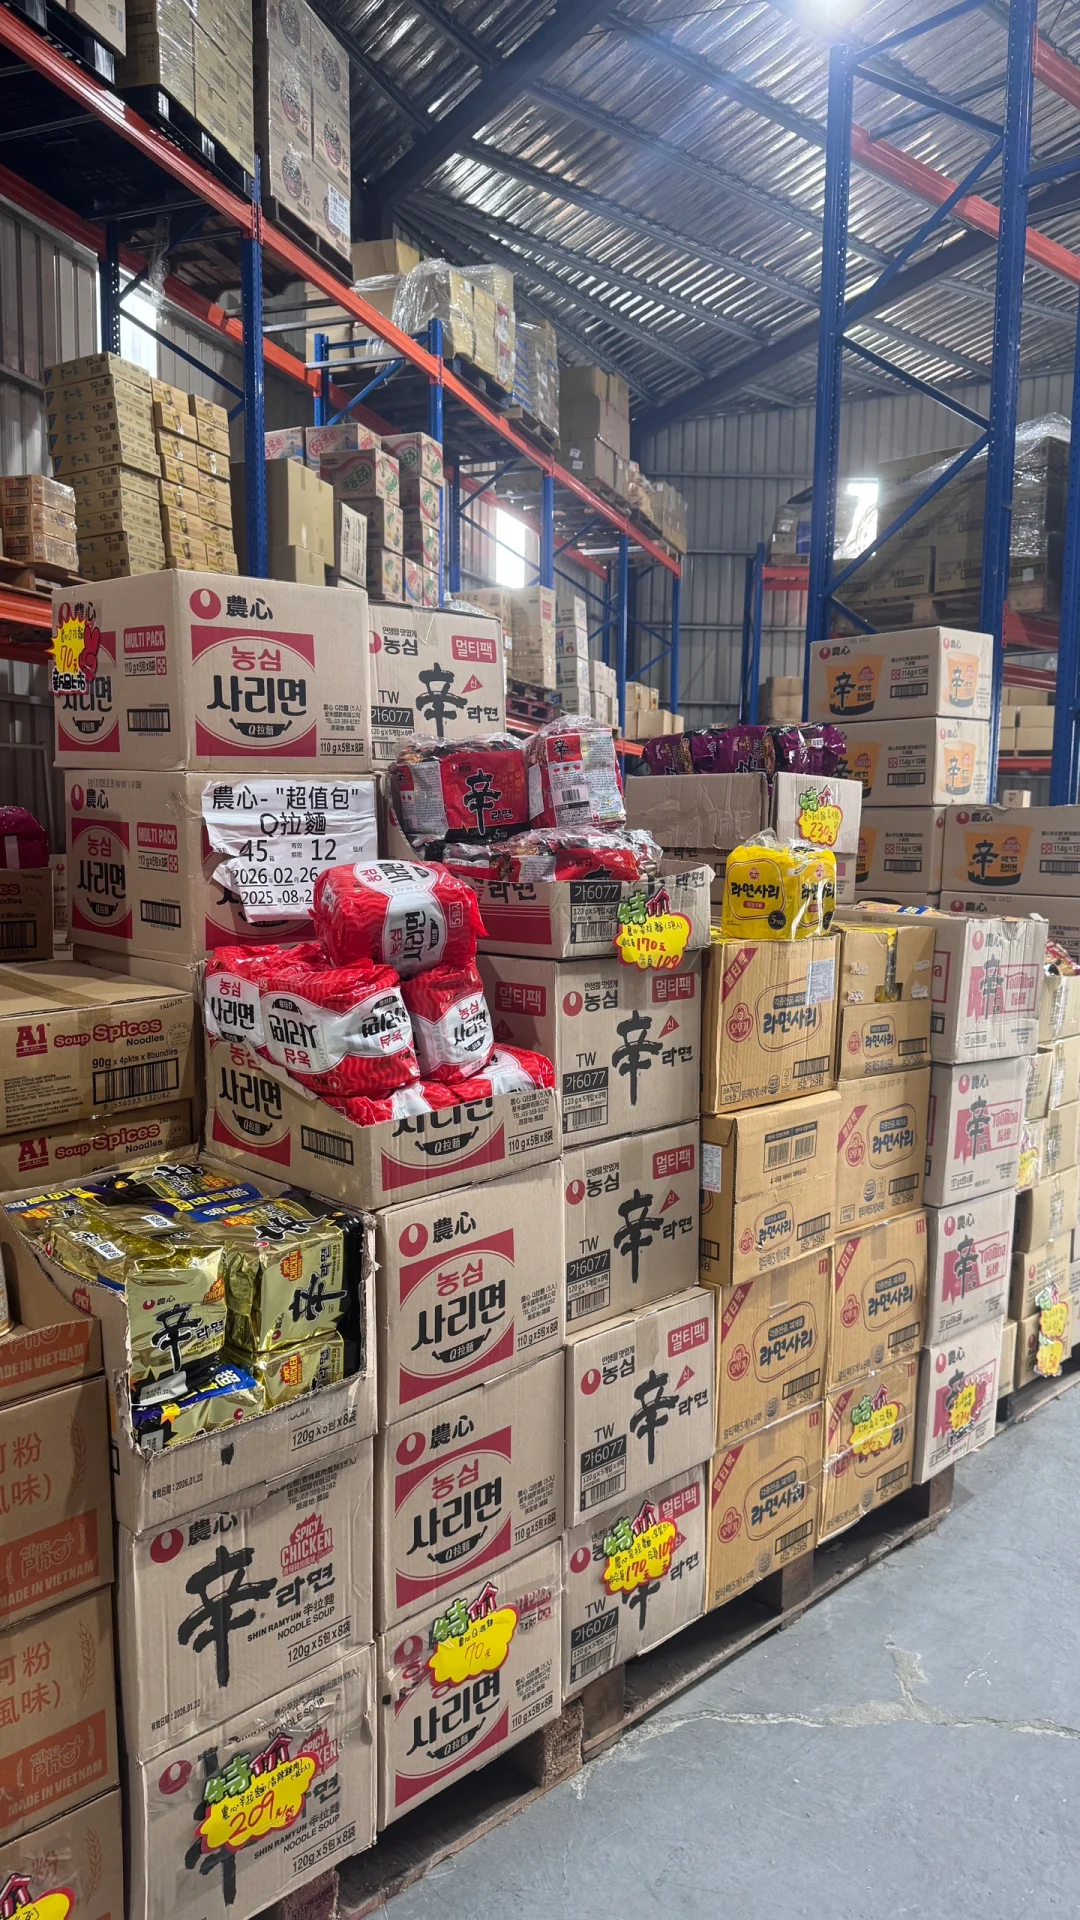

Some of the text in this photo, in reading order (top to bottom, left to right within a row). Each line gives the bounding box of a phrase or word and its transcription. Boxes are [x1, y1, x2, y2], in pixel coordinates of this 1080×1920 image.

[226, 594, 273, 620] 農心
[125, 631, 164, 648] MULTI PACK
[382, 635, 418, 656] 농심
[455, 638, 493, 660] 멀티팩
[231, 646, 281, 672] 농심
[206, 675, 307, 716] 사리면
[378, 690, 400, 704] TW
[415, 662, 468, 737] 辛
[833, 671, 856, 710] 辛
[371, 709, 411, 724] 가6077
[466, 705, 500, 723] 라면
[248, 724, 274, 736] Q拉麵
[86, 788, 109, 809] 農心
[212, 785, 268, 810] 農心-
[463, 768, 501, 836] 辛
[260, 812, 326, 837] Q拉麵
[490, 808, 513, 822] 라면
[87, 834, 112, 857] 농심
[137, 826, 176, 845] MULTI PACK
[239, 839, 268, 862] 45
[311, 839, 337, 861] 12
[972, 839, 1000, 879] 辛
[77, 860, 127, 899] 사리면
[573, 884, 619, 900] 가6077
[731, 881, 780, 900] 라면사리
[617, 886, 671, 924] 特价
[404, 911, 427, 961] 사리면
[724, 951, 749, 988] 멀티팩
[219, 978, 241, 997] 농심
[500, 988, 541, 1012] 멀티팩
[656, 976, 691, 998] 멀티팩
[159, 999, 183, 1011] TAIWAN
[584, 990, 618, 1012] 농심
[54, 1019, 162, 1048] Soup Spices
[268, 1014, 317, 1048] 사리면
[666, 1018, 674, 1030] 신
[763, 1007, 817, 1034] 라면사리
[16, 1023, 47, 1048] A1
[126, 1033, 164, 1047] Noodles
[865, 1030, 894, 1048] 라면사리
[92, 1057, 111, 1069] 90g
[119, 1054, 139, 1066] 4pkts
[146, 1048, 178, 1060] 8bundles
[284, 1048, 311, 1068] 농심
[576, 1051, 597, 1068] TW
[611, 1009, 664, 1106] 辛
[661, 1045, 693, 1067] 라면
[219, 1067, 283, 1120] 사리면
[566, 1071, 606, 1091] 가6077
[966, 1095, 991, 1160] 辛
[18, 1137, 48, 1162] A1
[55, 1124, 161, 1159] Soup Spices
[126, 1139, 163, 1153] Noodles
[872, 1130, 914, 1154] 라면사리
[656, 1148, 691, 1175] 멀티팩
[586, 1172, 620, 1198] 농심
[668, 1194, 675, 1204] 신
[432, 1211, 477, 1244] 農心
[613, 1188, 664, 1284] 辛
[662, 1215, 694, 1240] 라면
[579, 1235, 599, 1255] TW
[436, 1258, 484, 1297] 농심
[569, 1253, 608, 1278] 가6077
[954, 1234, 979, 1299] 辛
[157, 1294, 175, 1305] 農心
[288, 1272, 347, 1322] 辛
[867, 1284, 914, 1316] 라면사리
[411, 1279, 506, 1351] 사리면
[151, 1303, 202, 1374] 辛
[196, 1319, 224, 1339] 라면
[671, 1322, 706, 1352] 멀티팩
[21, 1343, 85, 1373] IN VIETNAM
[760, 1328, 813, 1367] 라면사리
[602, 1356, 635, 1386] 농심
[682, 1370, 690, 1381] 신
[678, 1389, 708, 1416] 라면
[630, 1369, 679, 1465] 辛
[430, 1415, 474, 1450] 農心
[594, 1422, 615, 1443] TW
[584, 1438, 624, 1468] 가6077
[431, 1458, 479, 1500] 농심
[406, 1476, 502, 1556] 사리면
[662, 1487, 697, 1518] 멀티팩
[751, 1482, 805, 1526] 라면사리
[188, 1511, 238, 1546] 農心
[295, 1518, 320, 1543] SPICY
[604, 1500, 657, 1556] 特价
[281, 1528, 332, 1567] CHICKEN
[671, 1551, 699, 1581] 라면
[275, 1562, 336, 1608] 라면
[177, 1545, 278, 1689] 辛
[433, 1581, 499, 1642] 特价
[585, 1597, 606, 1618] TW
[247, 1625, 267, 1643] SHIN
[268, 1610, 302, 1633] RAMYUN
[277, 1606, 335, 1641] NOODLE SOUP
[574, 1610, 616, 1642] 가6077
[288, 1641, 310, 1663] 120g
[406, 1670, 500, 1756] 사리면
[204, 1733, 292, 1803] 特价
[8, 1759, 103, 1818] MADE IN VIETNAM
[228, 1790, 274, 1841] 209
[283, 1828, 317, 1853] NOODLE
[318, 1813, 340, 1836] SOUP
[293, 1851, 314, 1873] 120g
